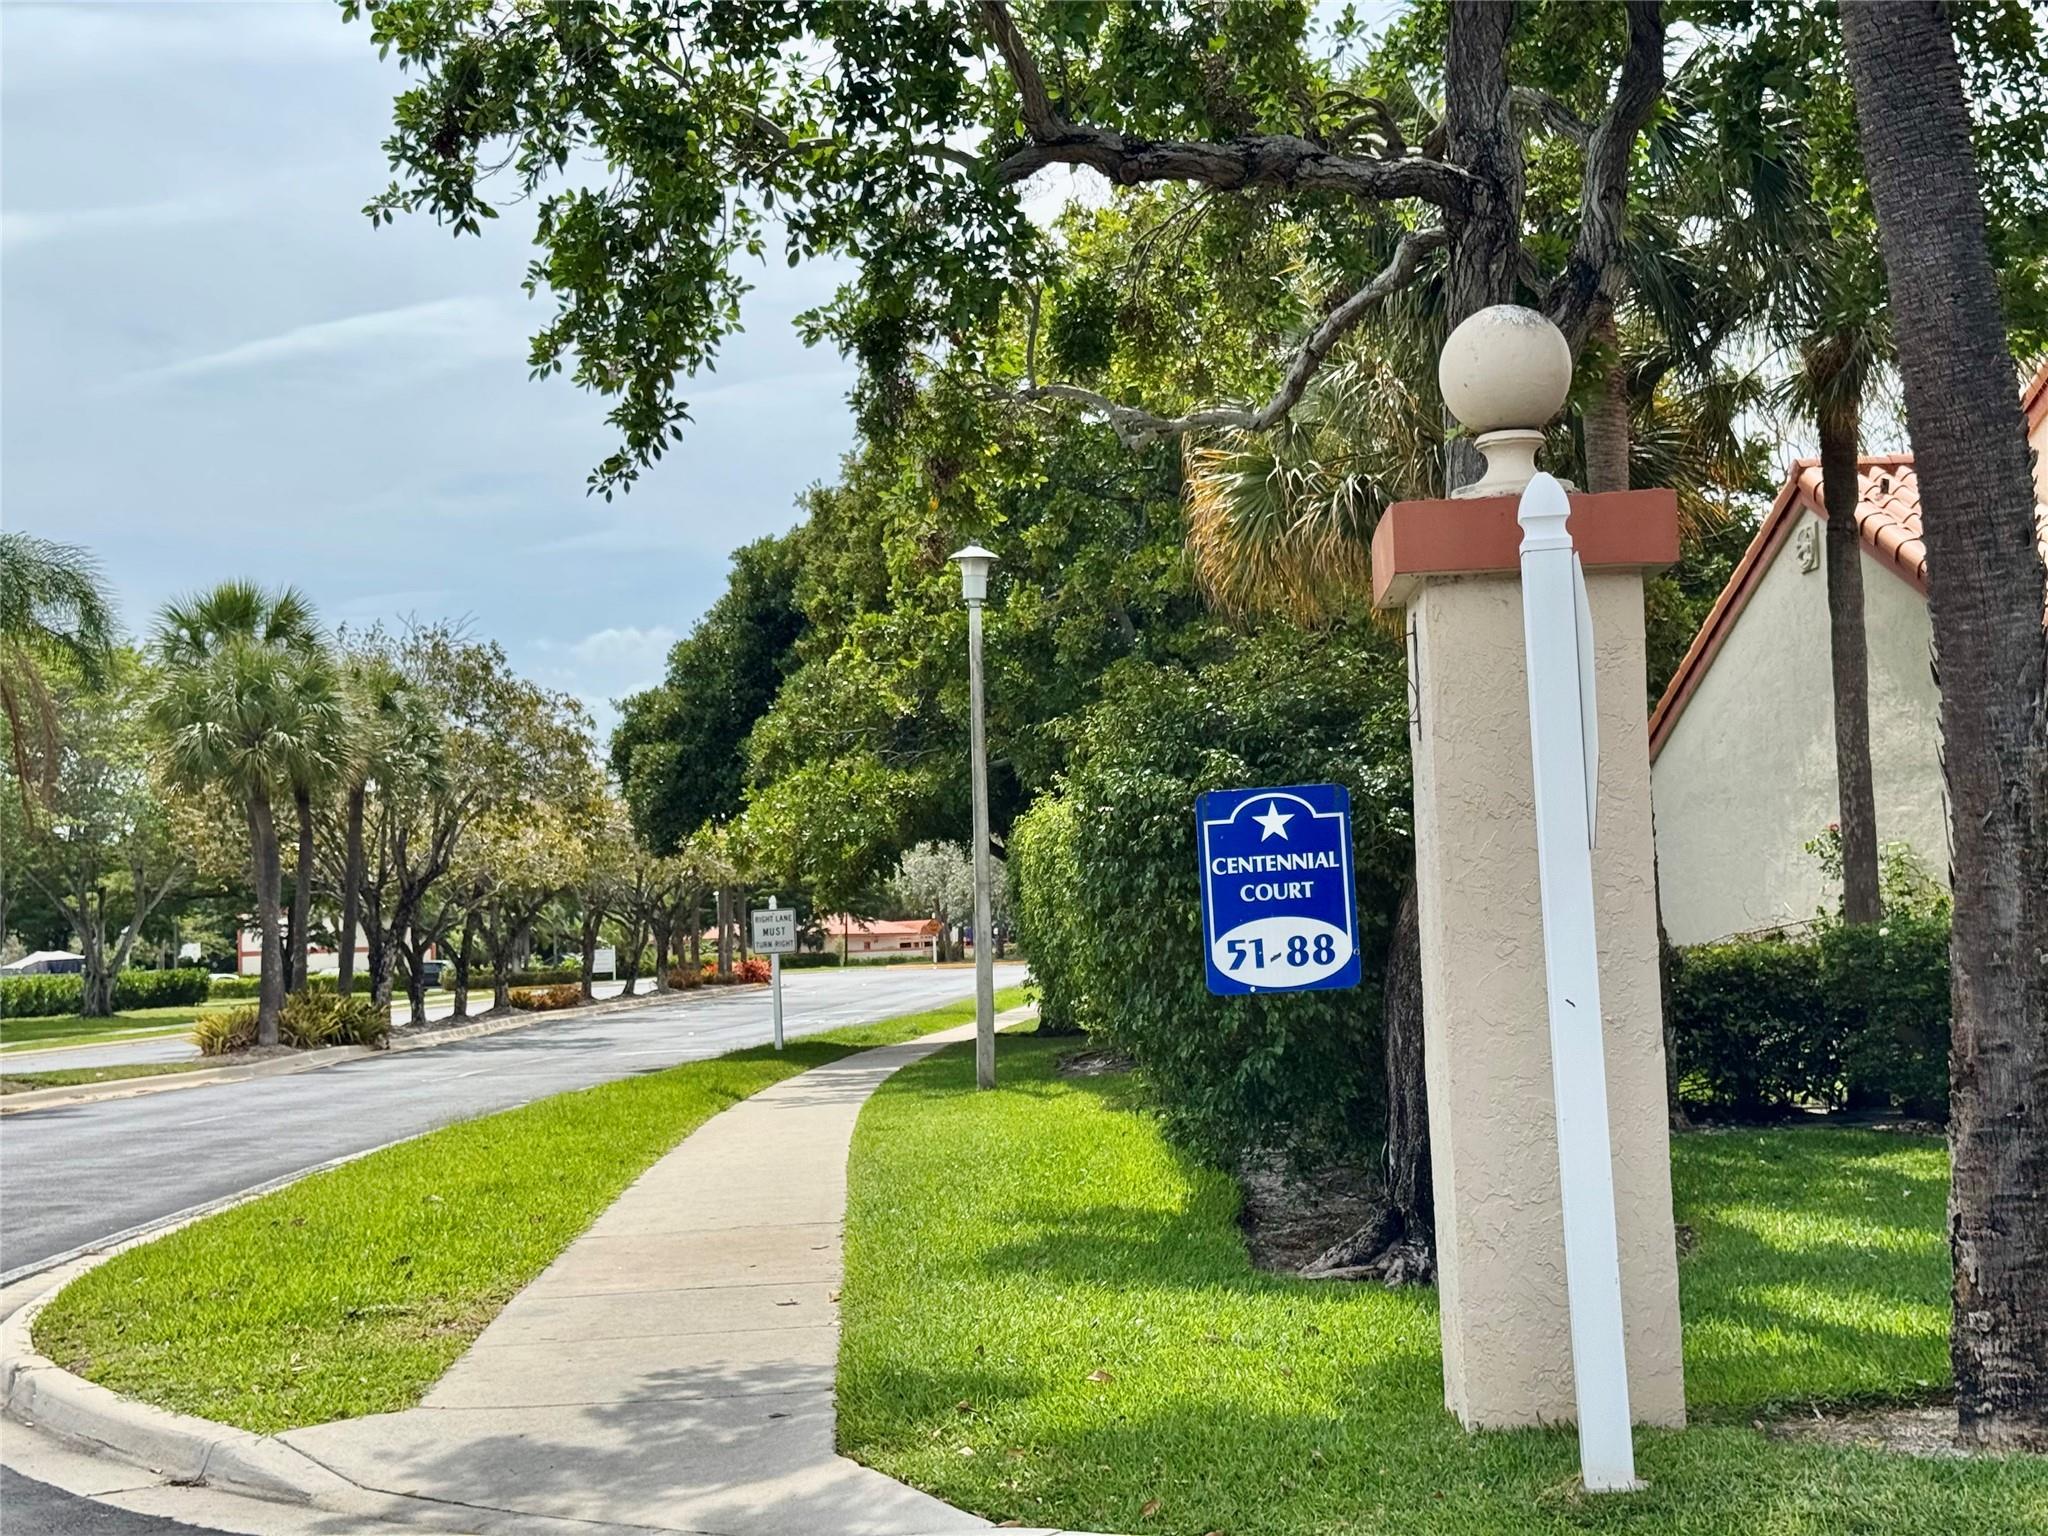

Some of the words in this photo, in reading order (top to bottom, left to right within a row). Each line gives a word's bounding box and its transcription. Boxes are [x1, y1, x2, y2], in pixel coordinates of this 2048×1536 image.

[1211, 850, 1340, 876] CENTENNIAL
[1239, 880, 1315, 903] COURT
[755, 915, 773, 923] RIGHT
[775, 914, 792, 923] LANE
[762, 926, 785, 936] MUST
[1226, 933, 1336, 971] 51-88
